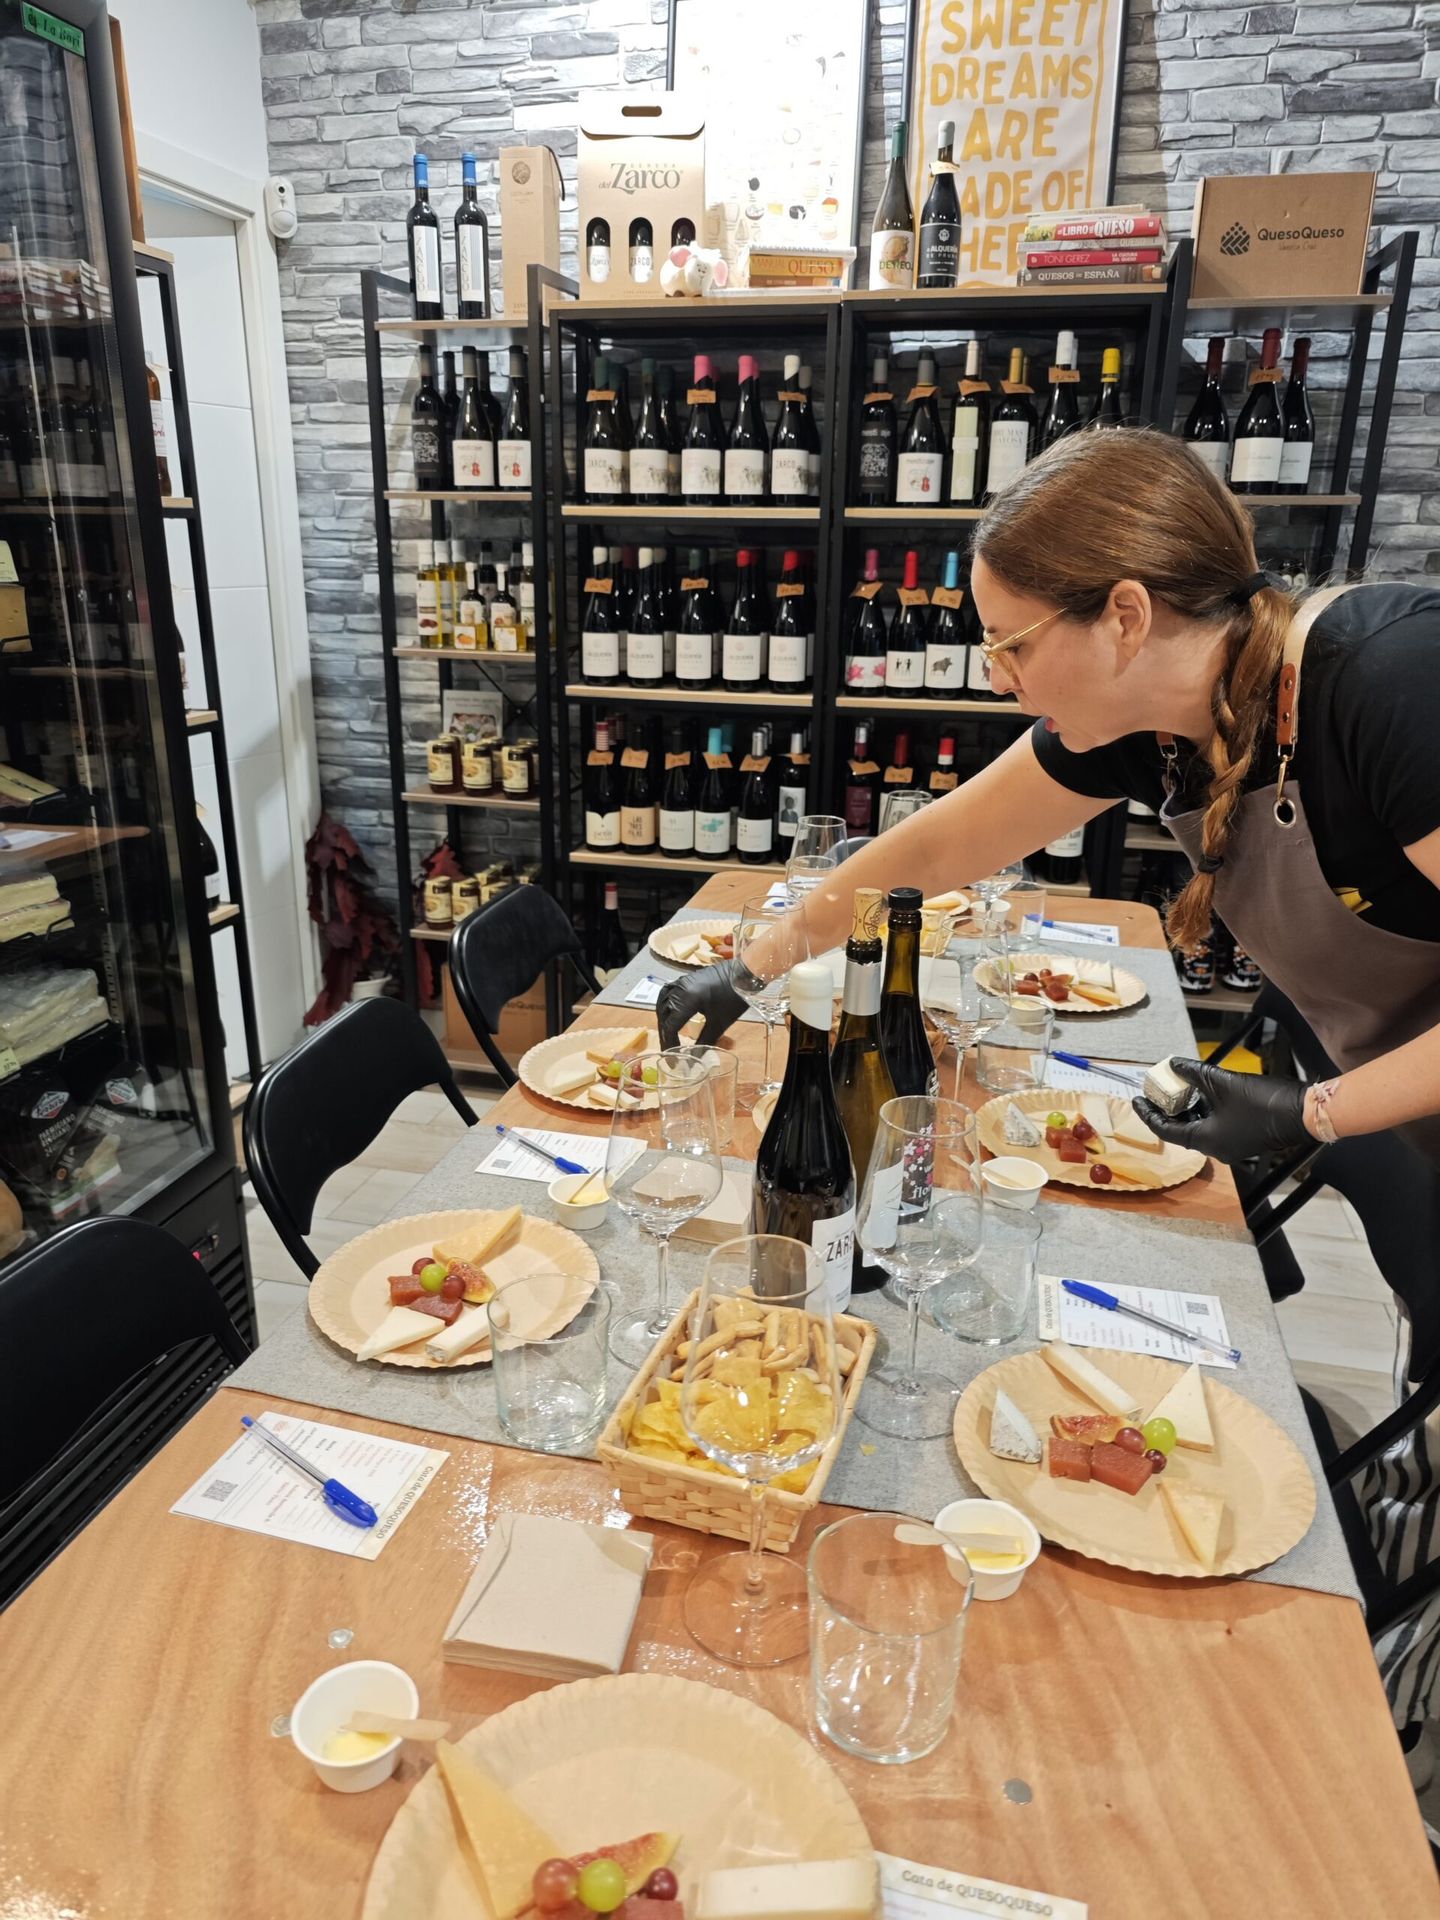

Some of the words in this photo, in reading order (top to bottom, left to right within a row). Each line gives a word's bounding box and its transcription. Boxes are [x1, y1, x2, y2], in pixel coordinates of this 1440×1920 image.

[941, 0, 1096, 54] SWEET
[930, 53, 1093, 105] DREAMS
[960, 107, 1059, 162] ARE
[610, 163, 681, 195] Zarco
[961, 170, 1033, 219] ADE
[1041, 169, 1084, 212] OF
[1062, 225, 1089, 236] LIBRO
[1094, 219, 1135, 238] QUESO
[1257, 226, 1345, 241] QuesoQueso
[788, 259, 834, 277] QUESO
[1044, 254, 1064, 264] TONI
[1038, 271, 1075, 280] QUESOS
[1084, 269, 1120, 279] ESPAÑA
[409, 1480, 422, 1491] de
[418, 1466, 434, 1483] Cata
[376, 1491, 414, 1539] QUESOQUESO
[902, 1869, 934, 1889] Cata
[937, 1879, 953, 1893] de
[956, 1884, 1053, 1917] QUESOQUESO
